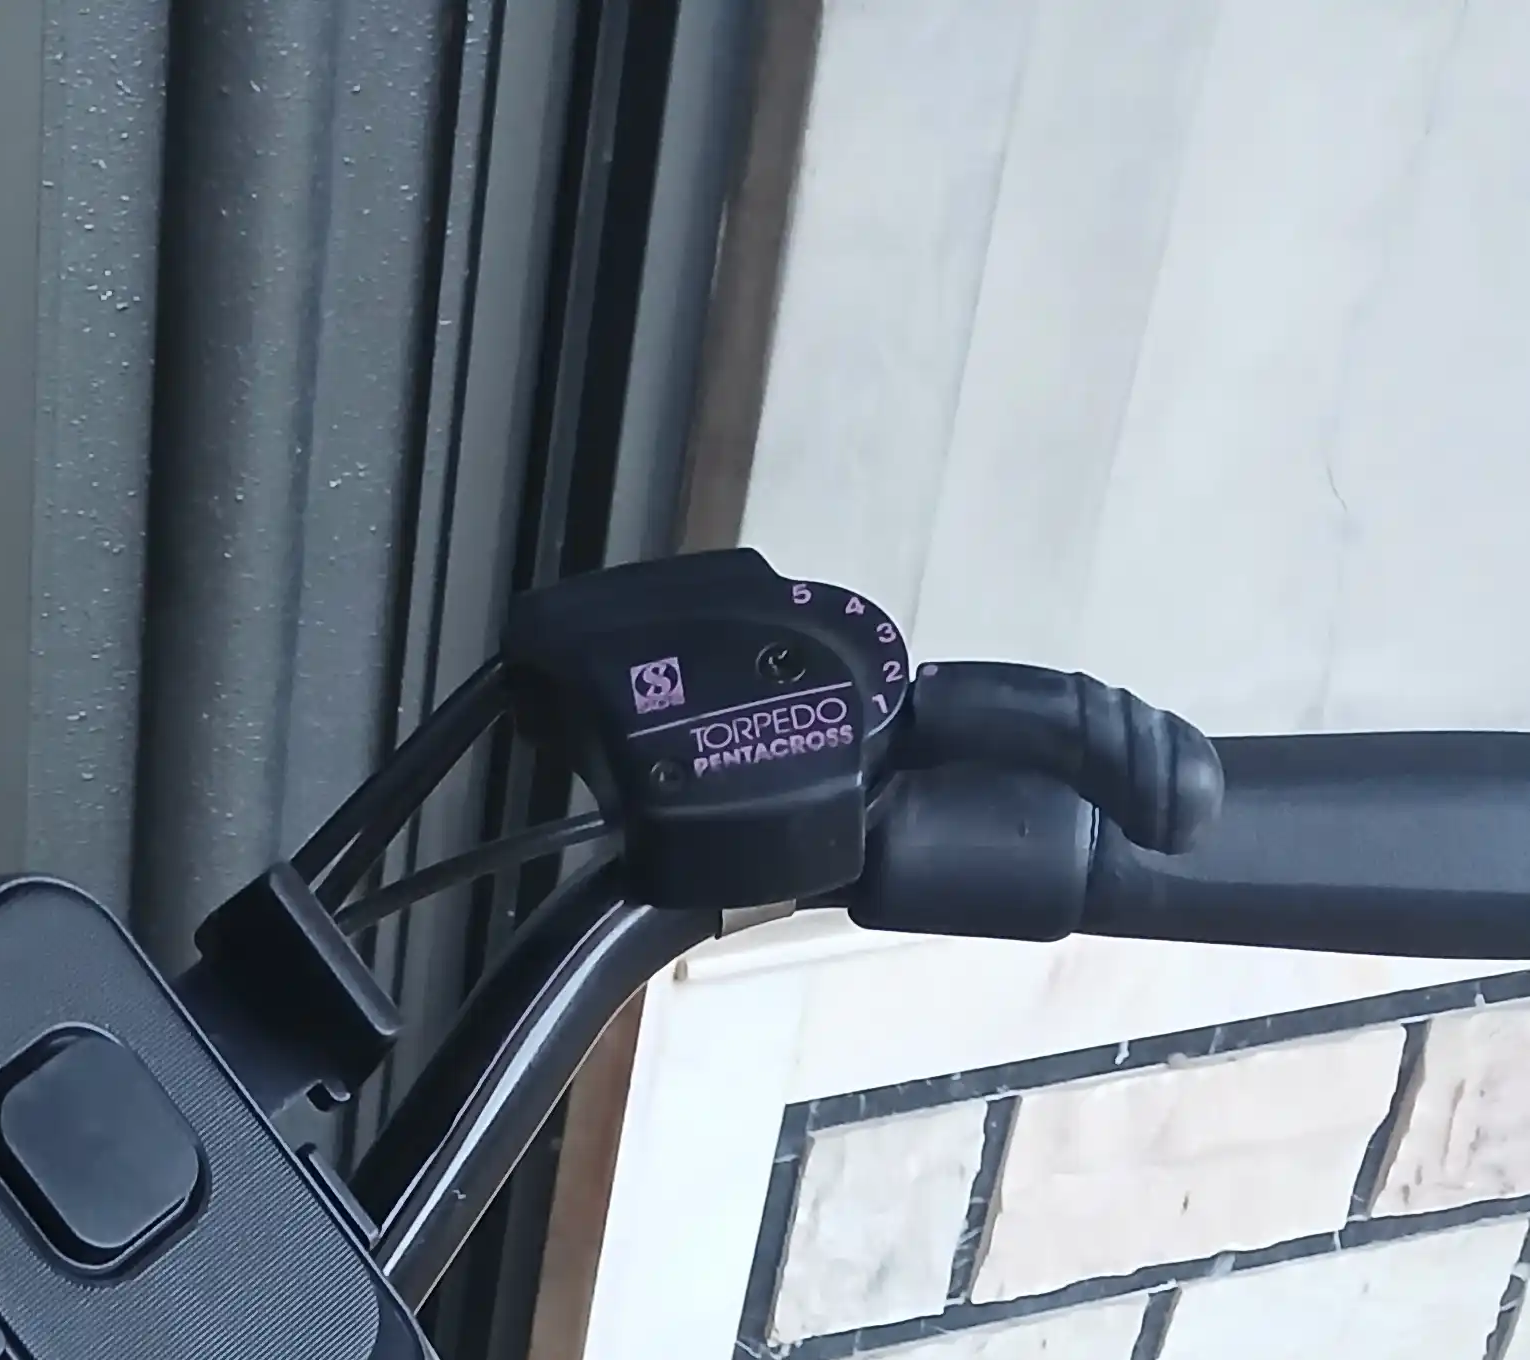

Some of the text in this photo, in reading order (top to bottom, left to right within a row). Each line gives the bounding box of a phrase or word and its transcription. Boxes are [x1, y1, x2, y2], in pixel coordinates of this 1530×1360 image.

[792, 583, 903, 714] 5 4 3 2 1
[689, 697, 848, 753] TORPEDO
[693, 724, 854, 778] PENTACROSS
